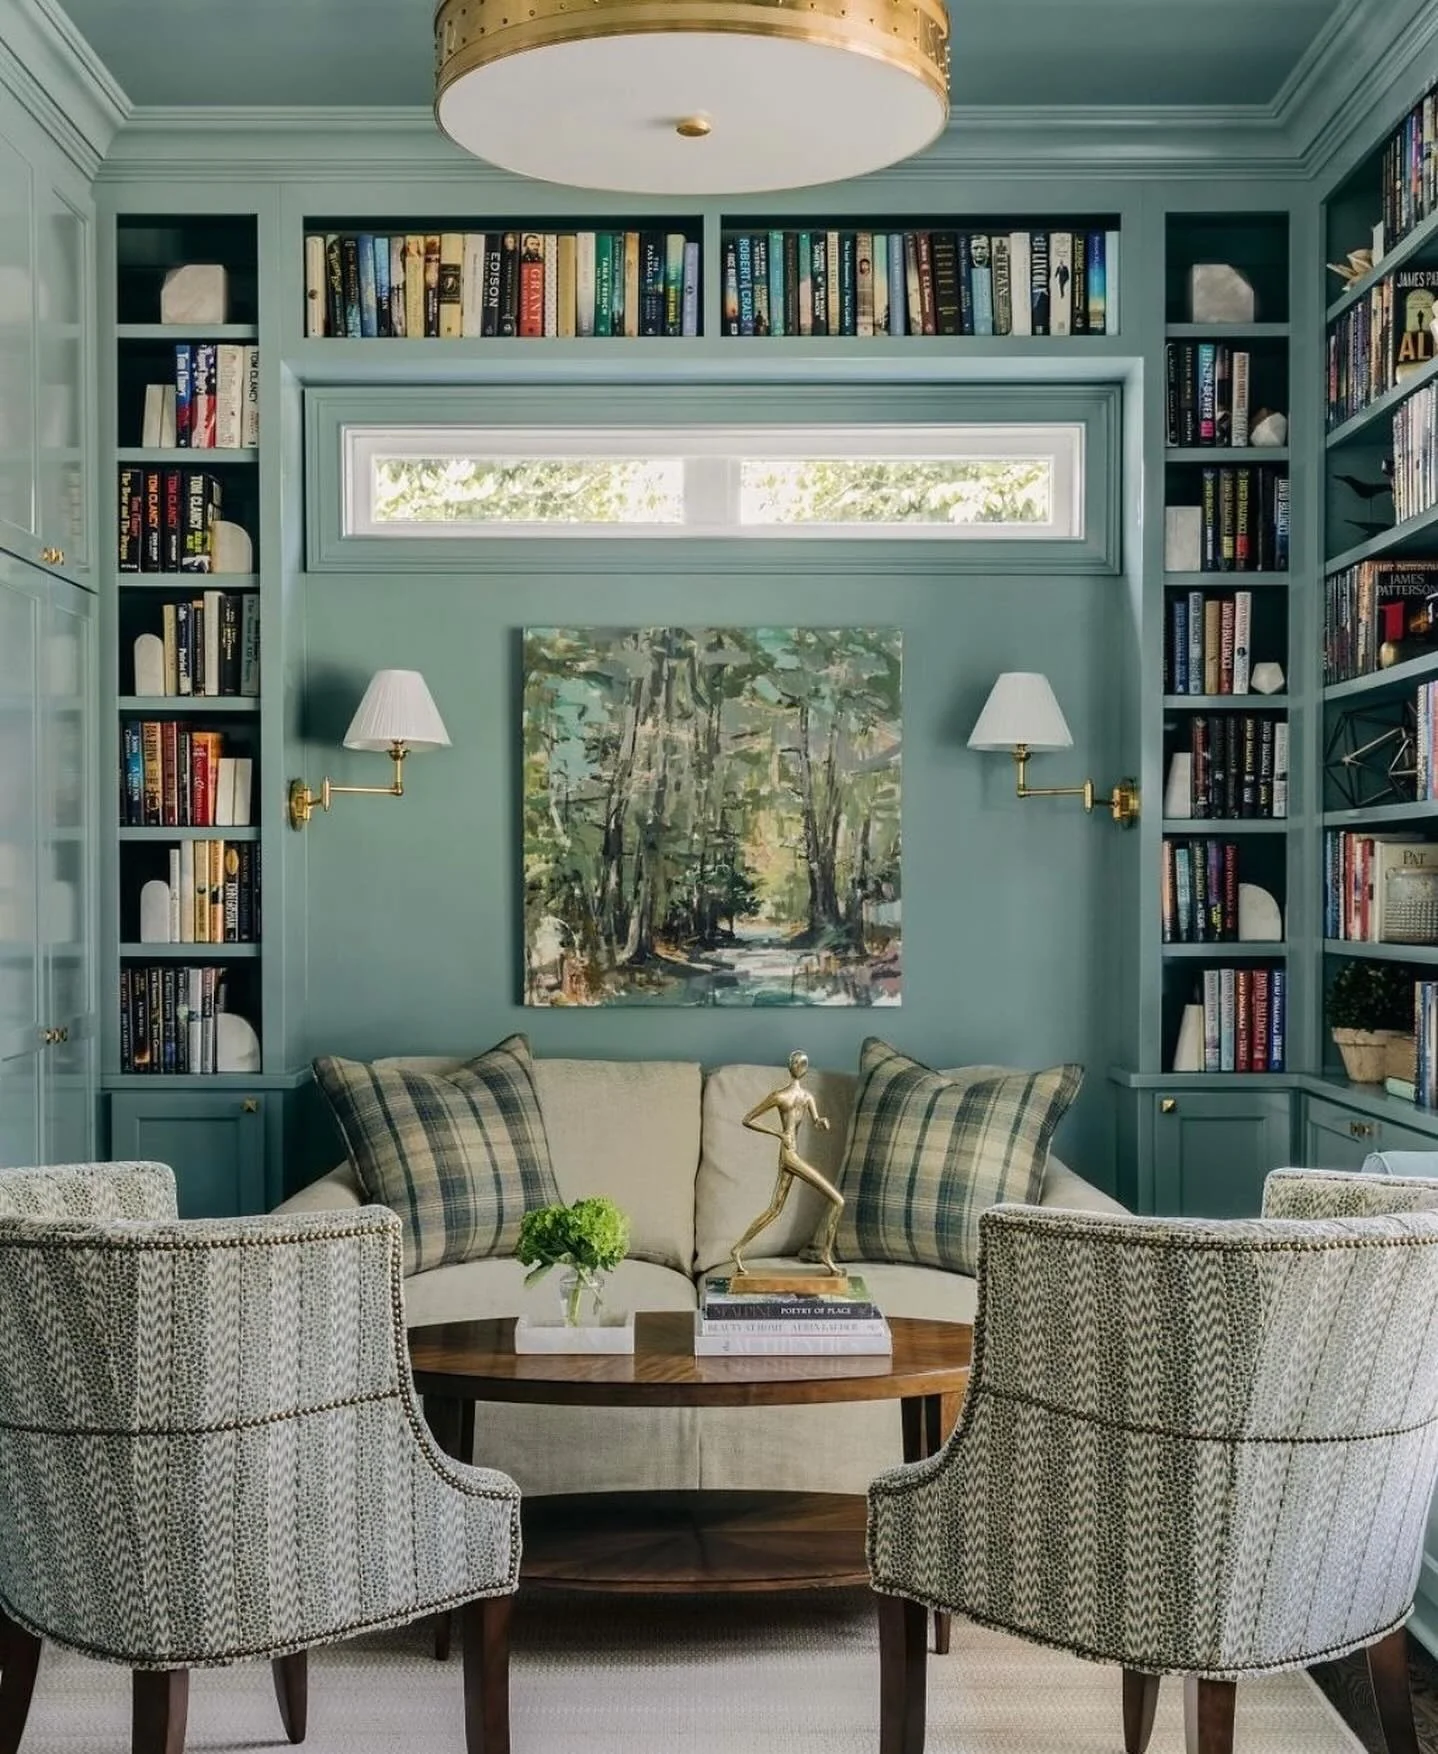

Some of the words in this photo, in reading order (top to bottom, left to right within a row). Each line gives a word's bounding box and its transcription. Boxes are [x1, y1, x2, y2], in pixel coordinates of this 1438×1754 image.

[601, 256, 609, 280] TANA
[646, 244, 655, 285] PASSAGE
[652, 256, 660, 272] THE
[739, 238, 751, 281] ROBERT
[489, 251, 501, 308] EDISON
[997, 254, 1009, 296] TITAN
[1396, 271, 1424, 288] JAMES
[529, 268, 541, 322] GRANT
[742, 290, 752, 321] CRAIS
[250, 351, 258, 370] TOM
[249, 370, 258, 405] CLANCY
[148, 474, 158, 493] TOM
[168, 475, 178, 494] TOM
[190, 475, 204, 494] TOM
[148, 493, 158, 529] CLANCY
[167, 494, 178, 529] CLANCY
[189, 496, 204, 530] CLANCY
[1391, 574, 1425, 585] JAMES
[1223, 603, 1233, 628] DAVID
[1222, 629, 1232, 669] BALDACCI
[1402, 851, 1427, 865] PAT
[1256, 972, 1267, 1000] DAVID
[1255, 1001, 1267, 1044] BALDACCI
[781, 1307, 811, 1315] POETRY
[814, 1307, 825, 1315] OF
[827, 1307, 852, 1315] PLACE
